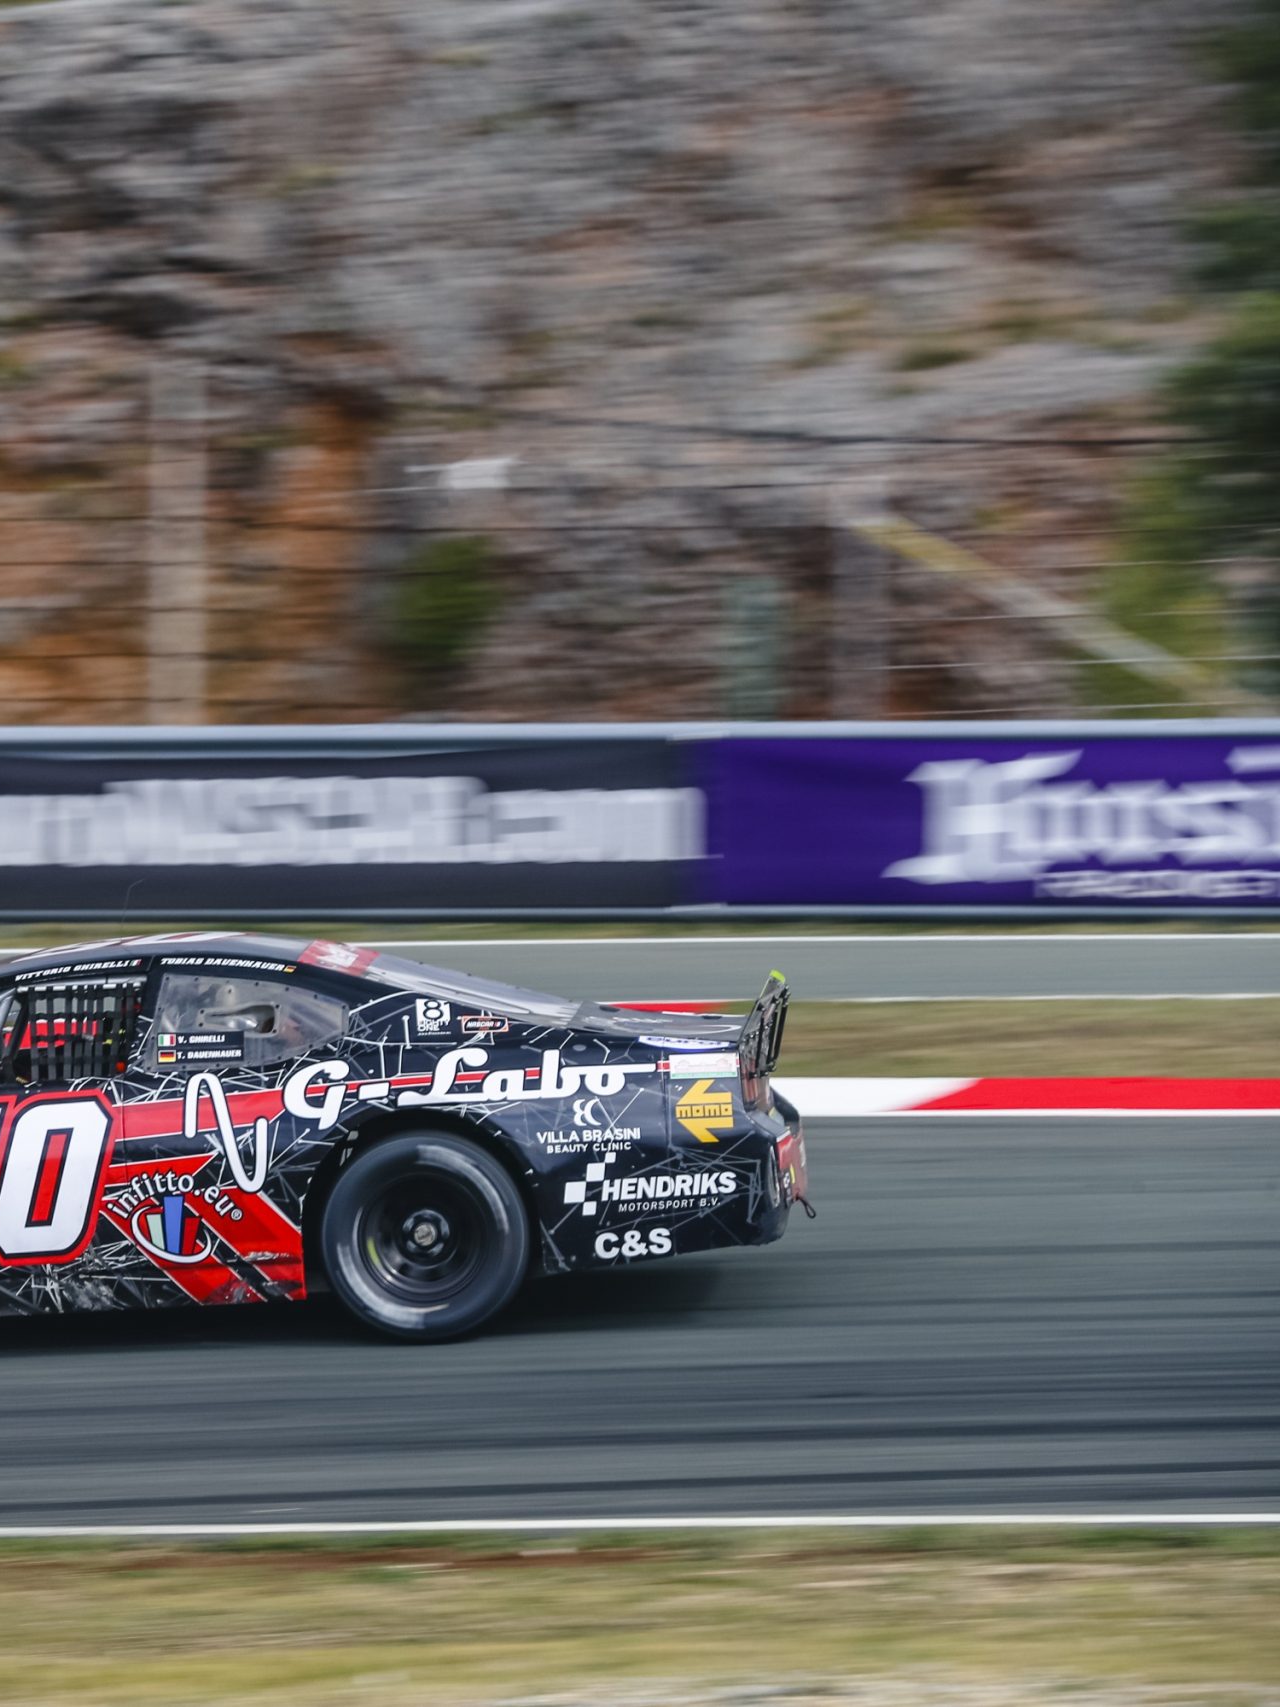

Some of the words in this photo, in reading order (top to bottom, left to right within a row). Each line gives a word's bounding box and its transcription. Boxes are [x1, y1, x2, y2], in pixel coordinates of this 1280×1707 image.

[161, 957, 205, 965] TOBIAS
[15, 965, 73, 981] VITTORIO
[73, 960, 130, 972] GHIRELLI
[537, 1130, 579, 1144] VILLA
[582, 1127, 641, 1143] BRASINI
[547, 1144, 588, 1154] BEAUTY
[593, 1141, 632, 1151] CLINIC
[601, 1171, 737, 1201] HENDRIKS
[619, 1198, 695, 1213] MOTORSPORT
[594, 1227, 673, 1259] C&S
